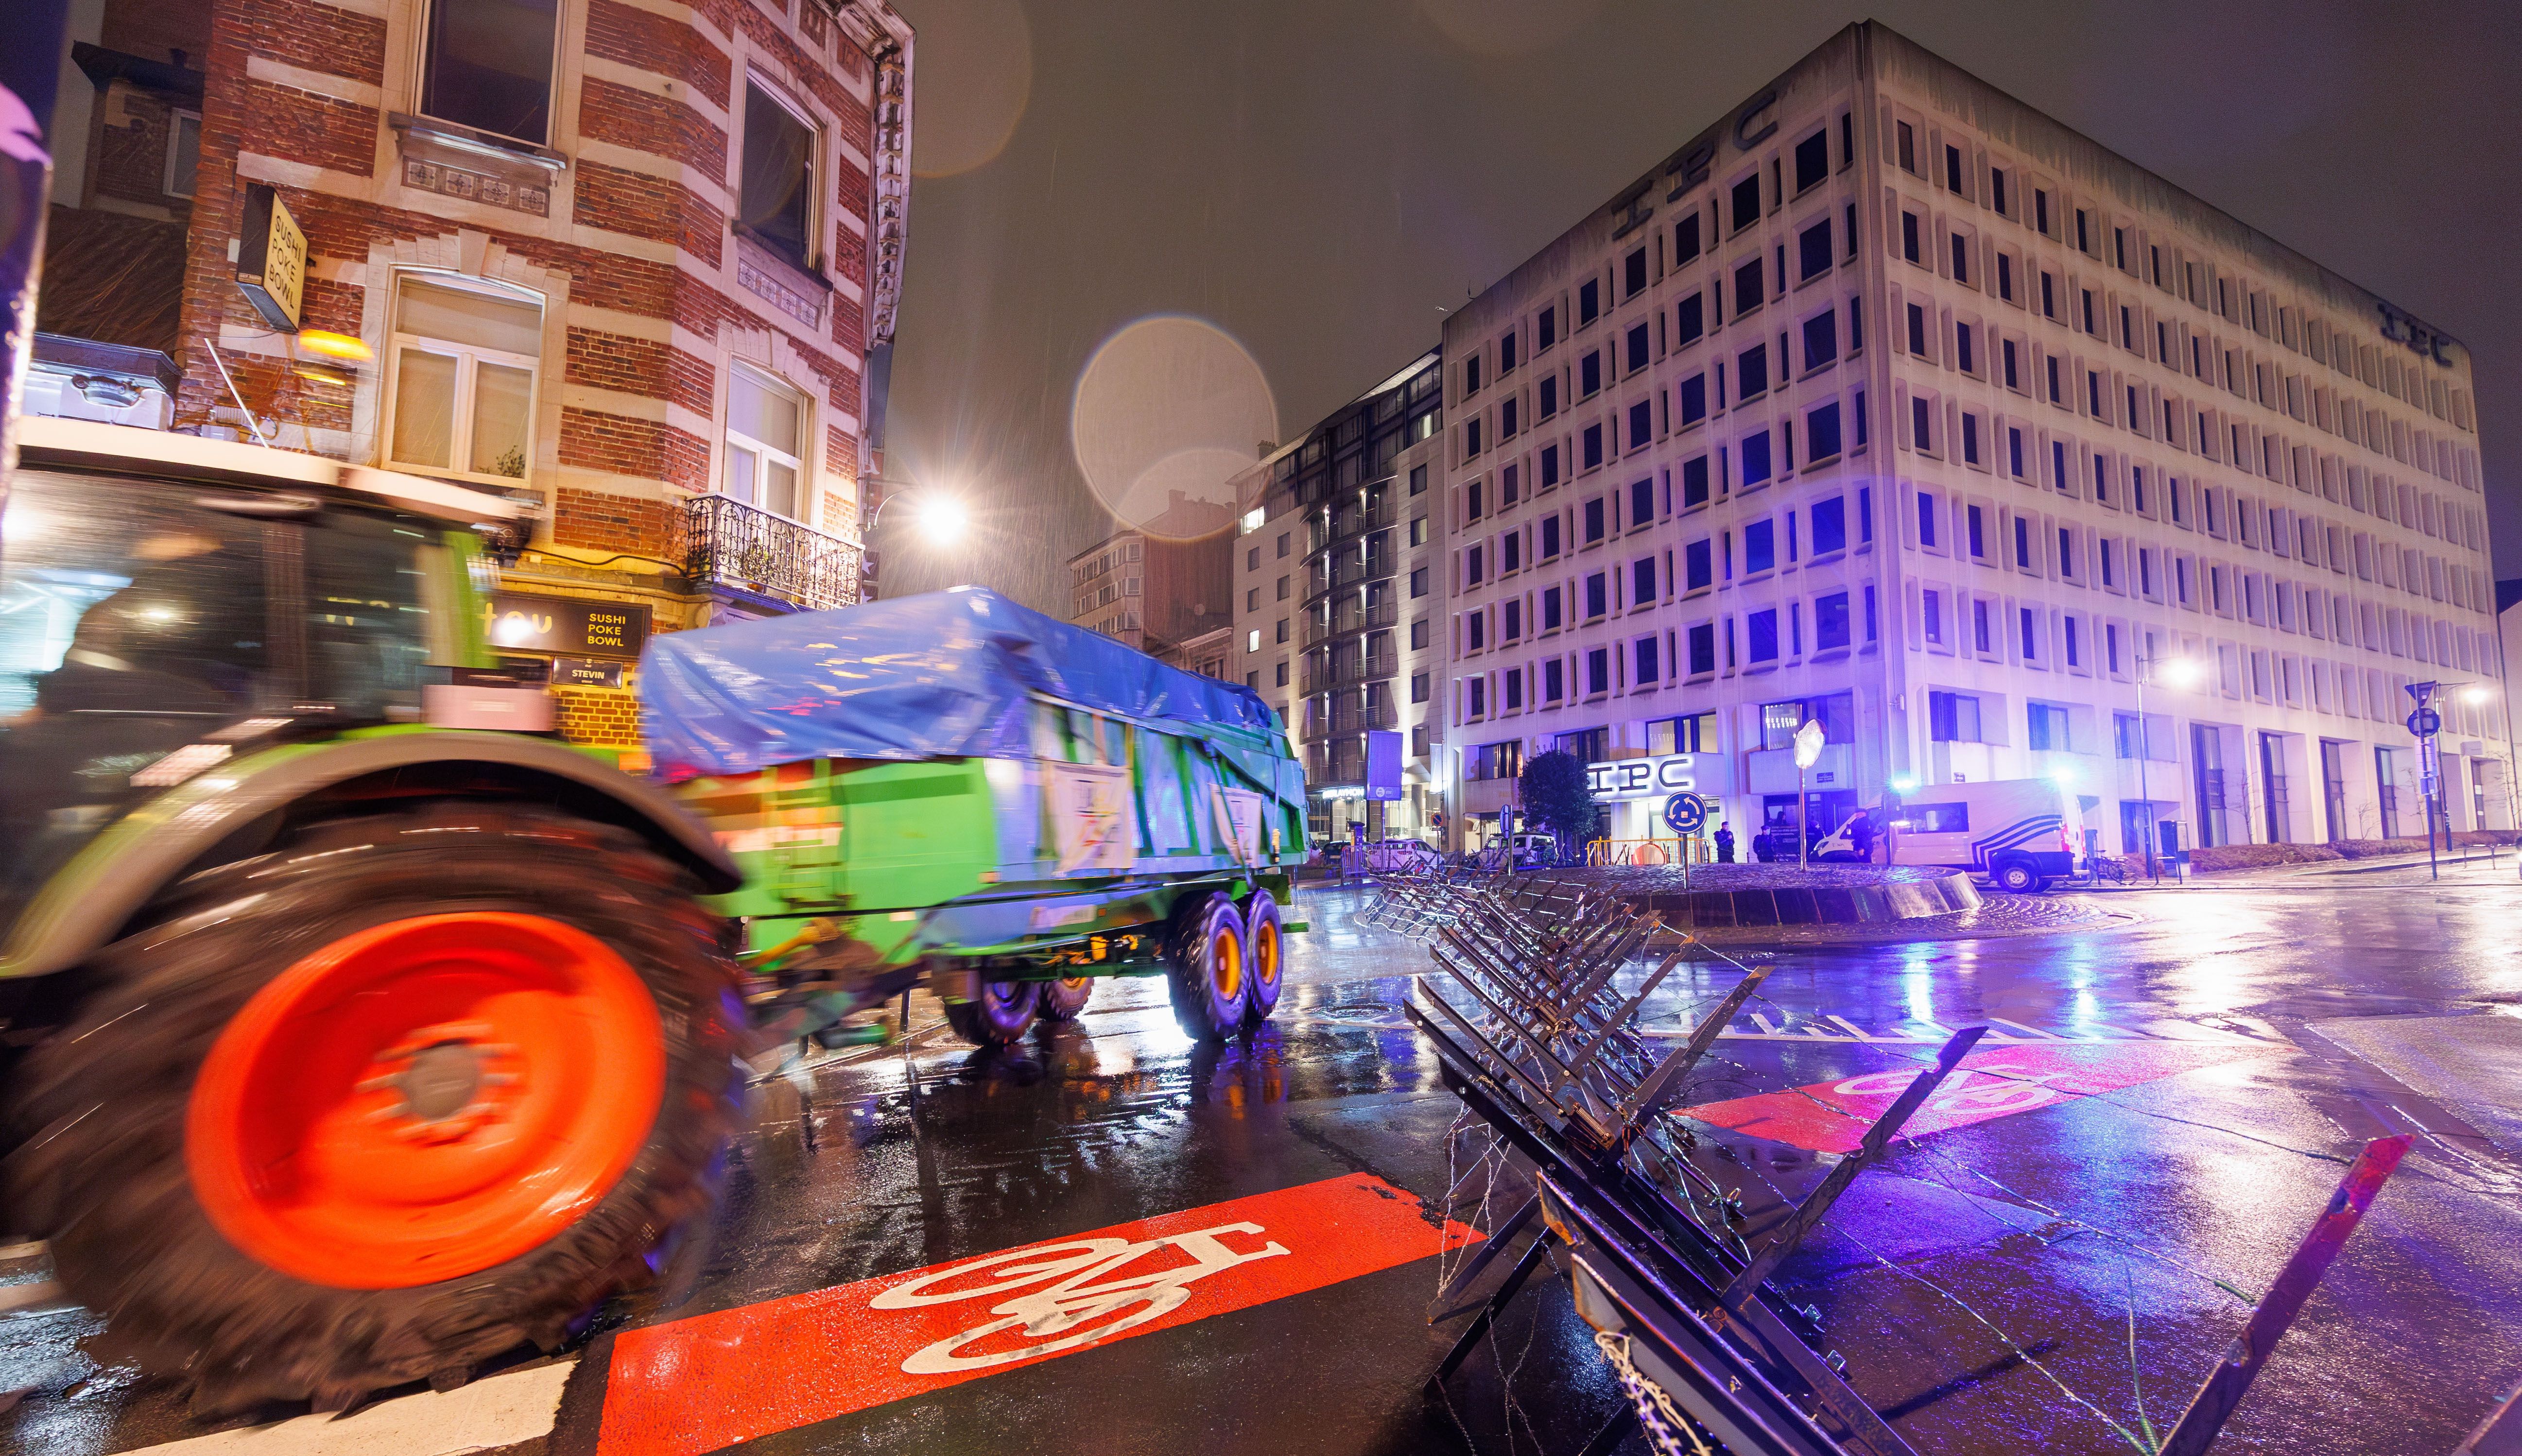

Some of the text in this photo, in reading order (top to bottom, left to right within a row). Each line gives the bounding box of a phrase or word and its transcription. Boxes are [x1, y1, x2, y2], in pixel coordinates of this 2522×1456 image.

[1611, 91, 1778, 241] IPC
[275, 215, 301, 262] SUSHI
[271, 238, 296, 283] POKE
[269, 263, 294, 309] BOWL
[588, 624, 622, 635] POKE
[589, 613, 626, 625] SUSHI
[587, 635, 624, 647] BOWL
[571, 669, 605, 680] STEVIN
[1586, 758, 1690, 793] IPC
